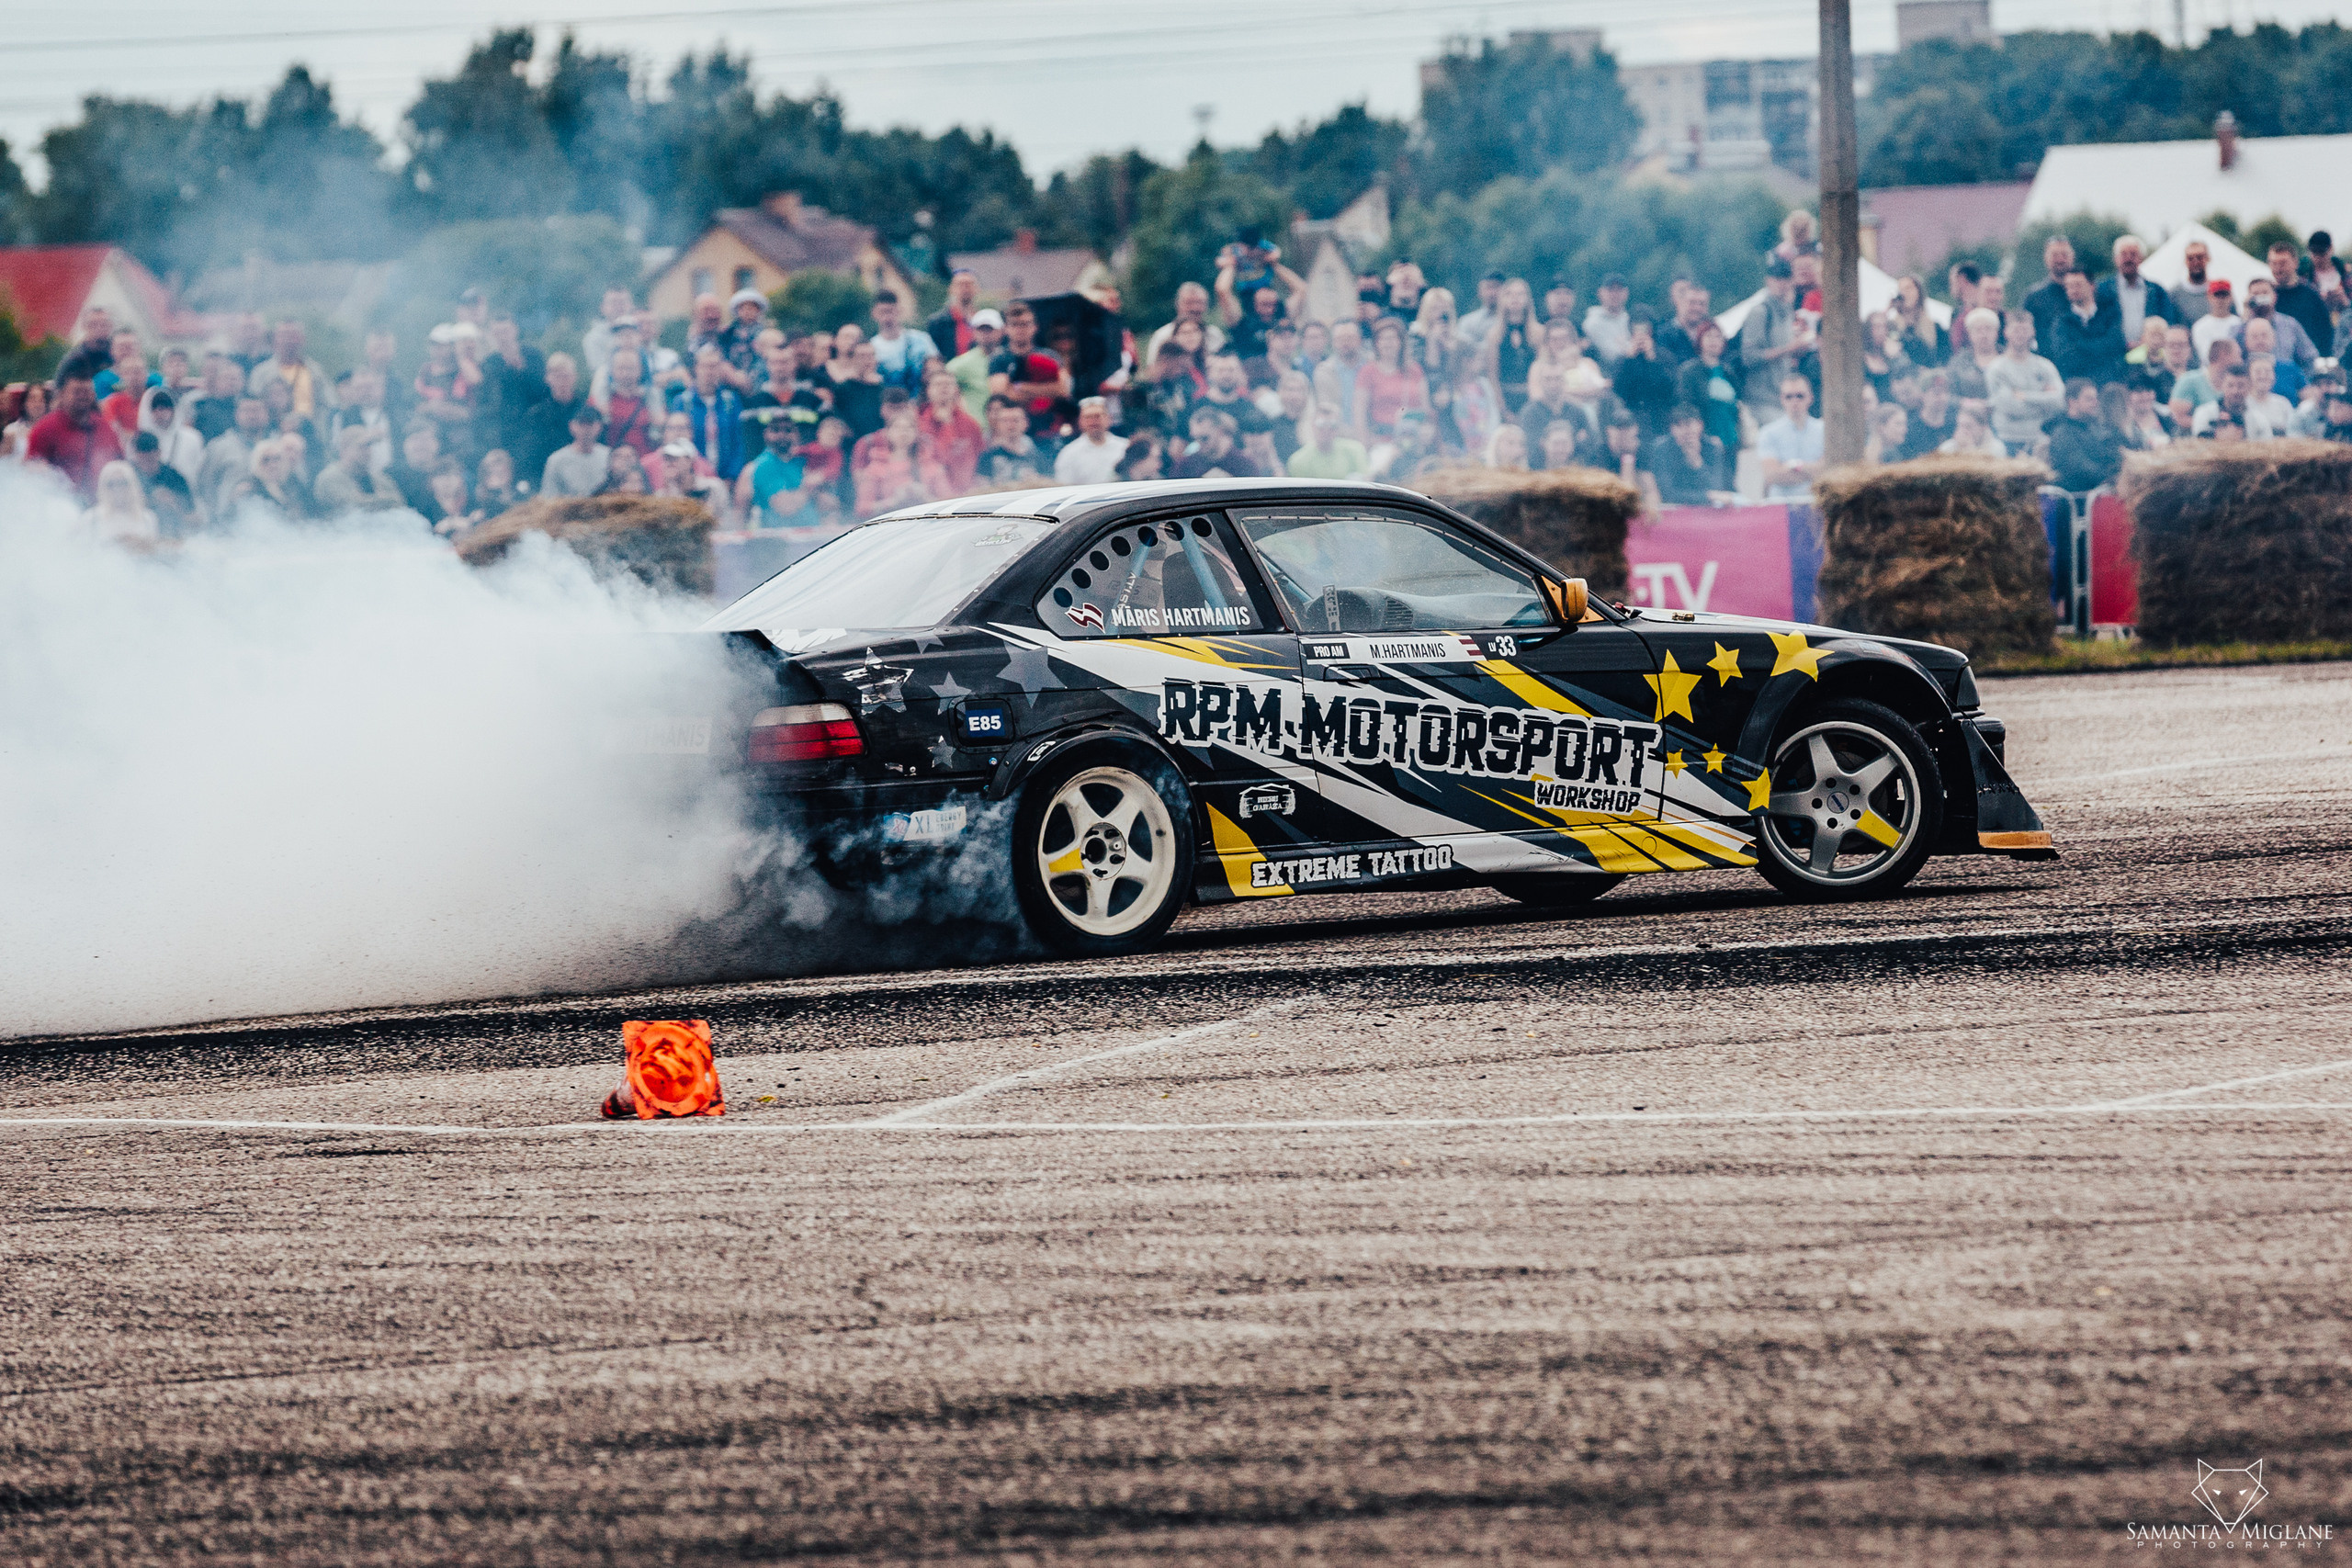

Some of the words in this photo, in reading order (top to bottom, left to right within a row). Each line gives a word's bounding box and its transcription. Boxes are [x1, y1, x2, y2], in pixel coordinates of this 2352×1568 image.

[1111, 605, 1160, 626] MĀRIS
[1162, 606, 1250, 626] HARTMANIS
[1313, 646, 1329, 658] PRO
[1330, 645, 1344, 657] AM
[1369, 643, 1446, 659] M.HARTMANIS
[1487, 641, 1497, 653] LV
[1495, 636, 1516, 657] 33
[968, 715, 1001, 732] E85
[1298, 693, 1658, 788] MOTORSPORT
[1537, 783, 1642, 813] WORKSHOP
[914, 814, 933, 834] XL
[1252, 854, 1361, 887] EXTREME
[1368, 846, 1452, 876] TATTOO
